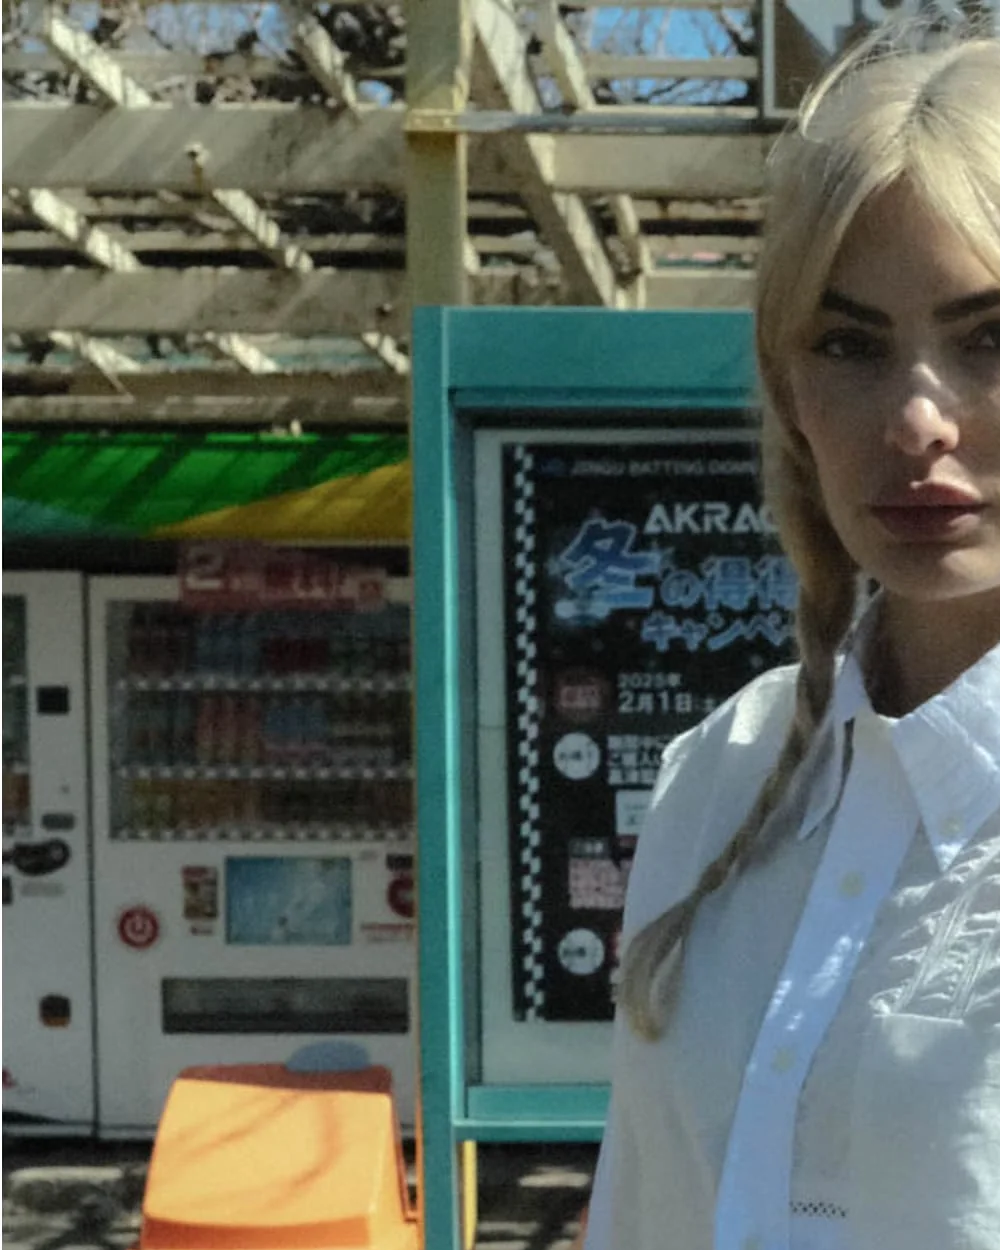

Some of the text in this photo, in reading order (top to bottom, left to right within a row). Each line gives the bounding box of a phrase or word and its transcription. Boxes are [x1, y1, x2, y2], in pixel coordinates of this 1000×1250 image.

[629, 459, 704, 476] BATTING
[641, 609, 798, 652] キャンペ
